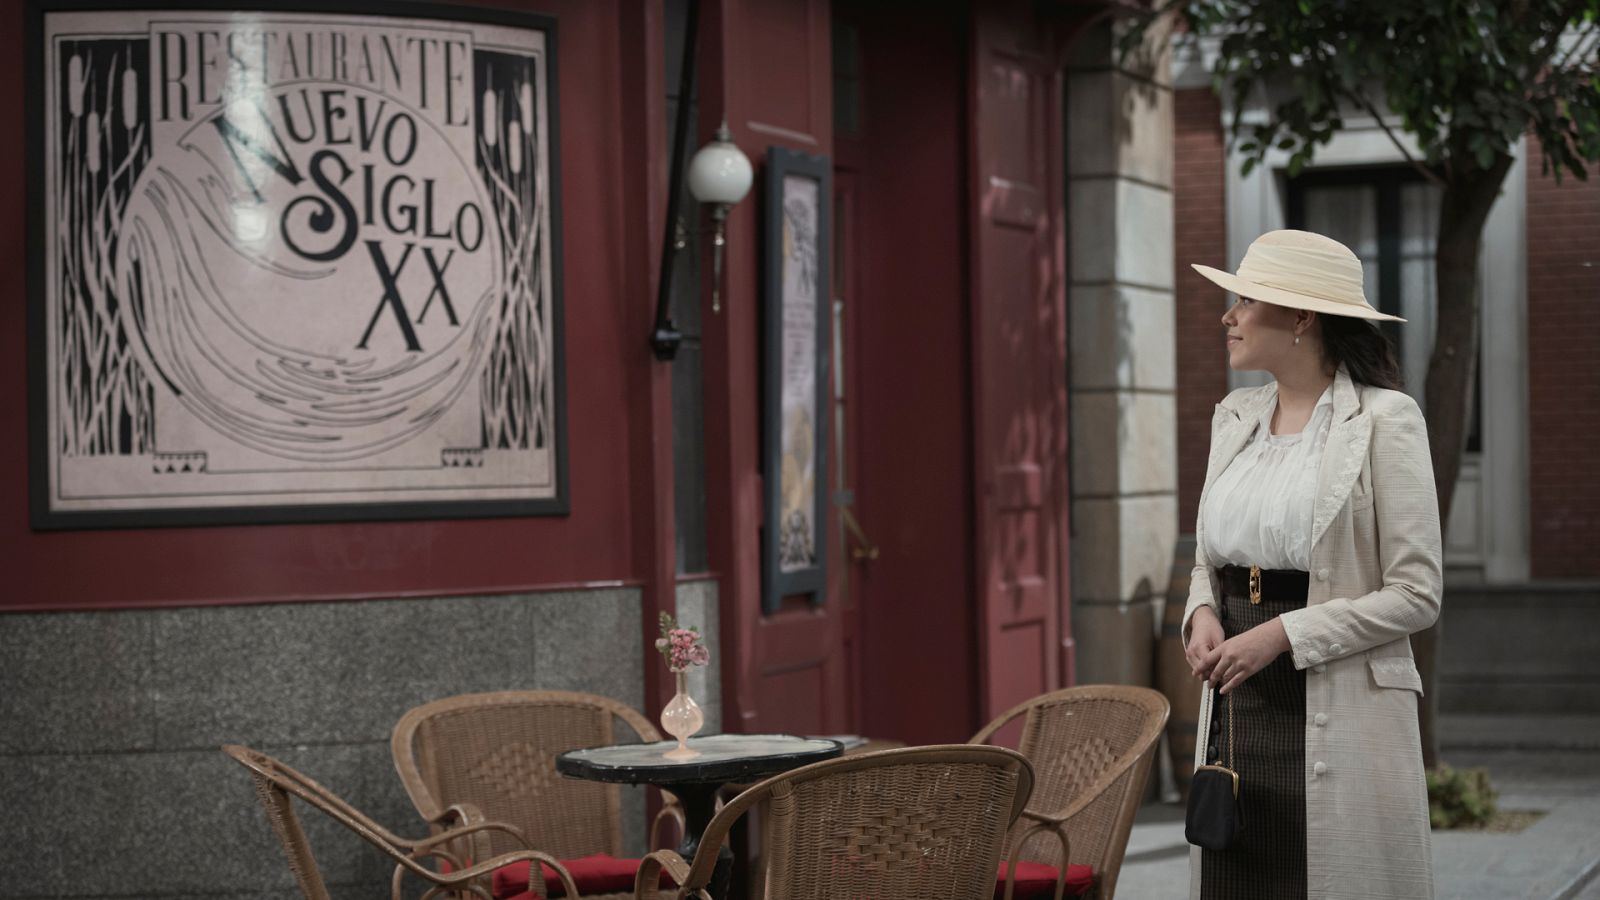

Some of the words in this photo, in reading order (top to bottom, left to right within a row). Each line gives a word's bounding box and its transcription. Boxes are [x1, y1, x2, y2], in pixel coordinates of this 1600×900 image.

[157, 31, 469, 127] RESTAURANTE
[213, 89, 417, 203] NUEVO
[281, 149, 484, 262] SIGLO
[355, 241, 461, 352] XX
